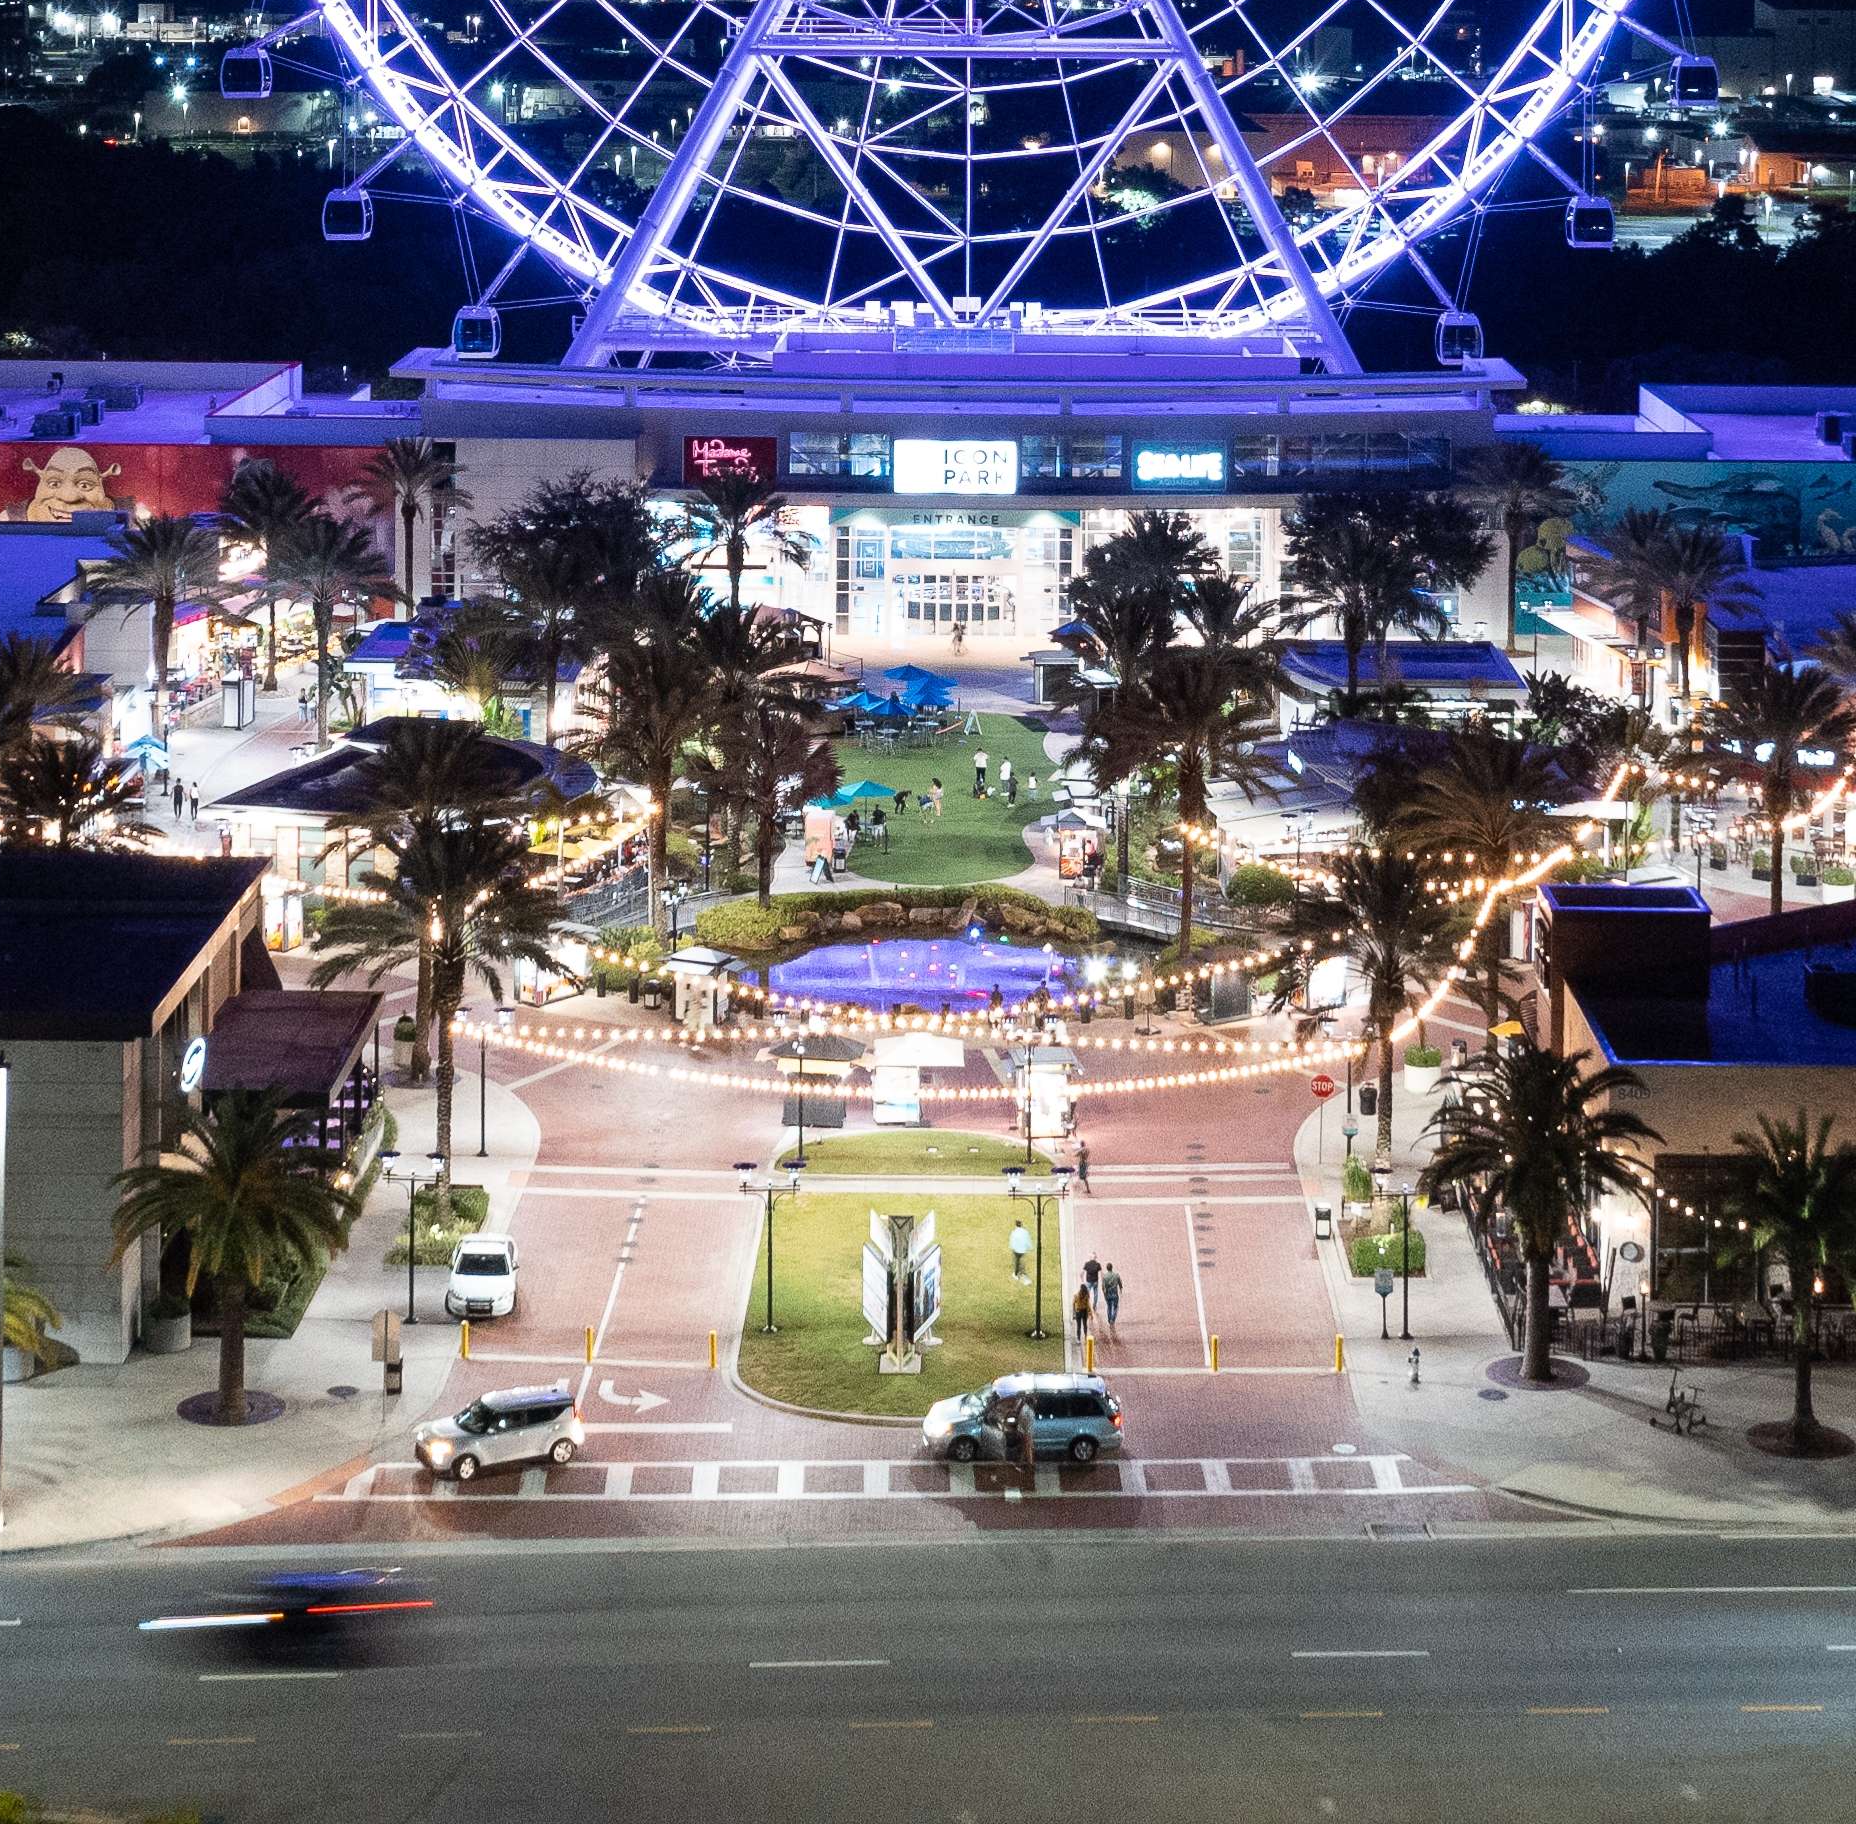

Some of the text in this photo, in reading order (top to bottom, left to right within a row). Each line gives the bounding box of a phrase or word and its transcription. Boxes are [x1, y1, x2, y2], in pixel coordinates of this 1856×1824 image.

[693, 439, 751, 458] Madame
[944, 449, 1007, 465] ICON
[913, 514, 1000, 525] ENTRANCE
[1311, 1081, 1334, 1092] STOP
